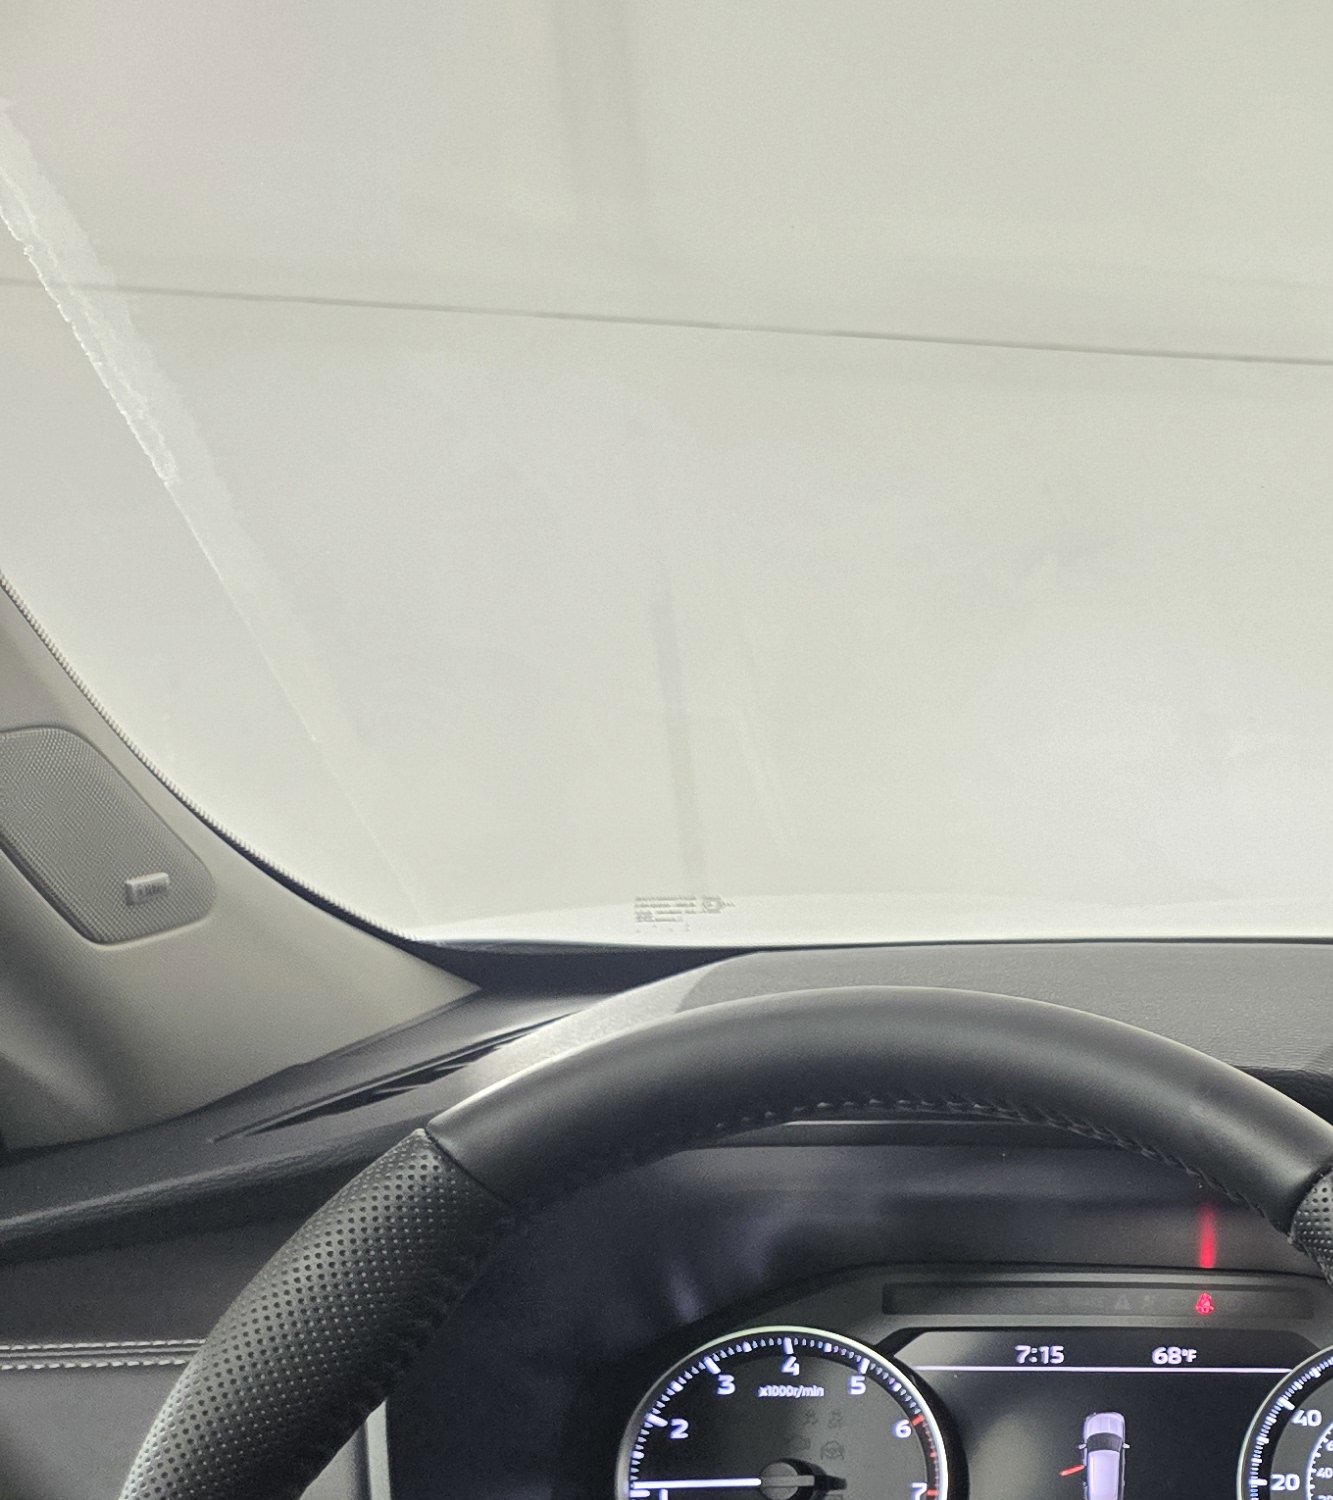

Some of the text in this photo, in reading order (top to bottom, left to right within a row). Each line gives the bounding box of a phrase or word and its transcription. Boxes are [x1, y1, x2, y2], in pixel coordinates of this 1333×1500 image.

[1015, 1344, 1065, 1365] 7:15
[1151, 1346, 1197, 1365] 68°F
[781, 1356, 800, 1376] 4
[716, 1374, 736, 1395] 3
[848, 1375, 867, 1396] 5
[1291, 1409, 1323, 1427] 40
[670, 1418, 690, 1440] 2
[893, 1420, 913, 1439] 6
[1270, 1473, 1301, 1491] 20
[1315, 1467, 1333, 1479] 40
